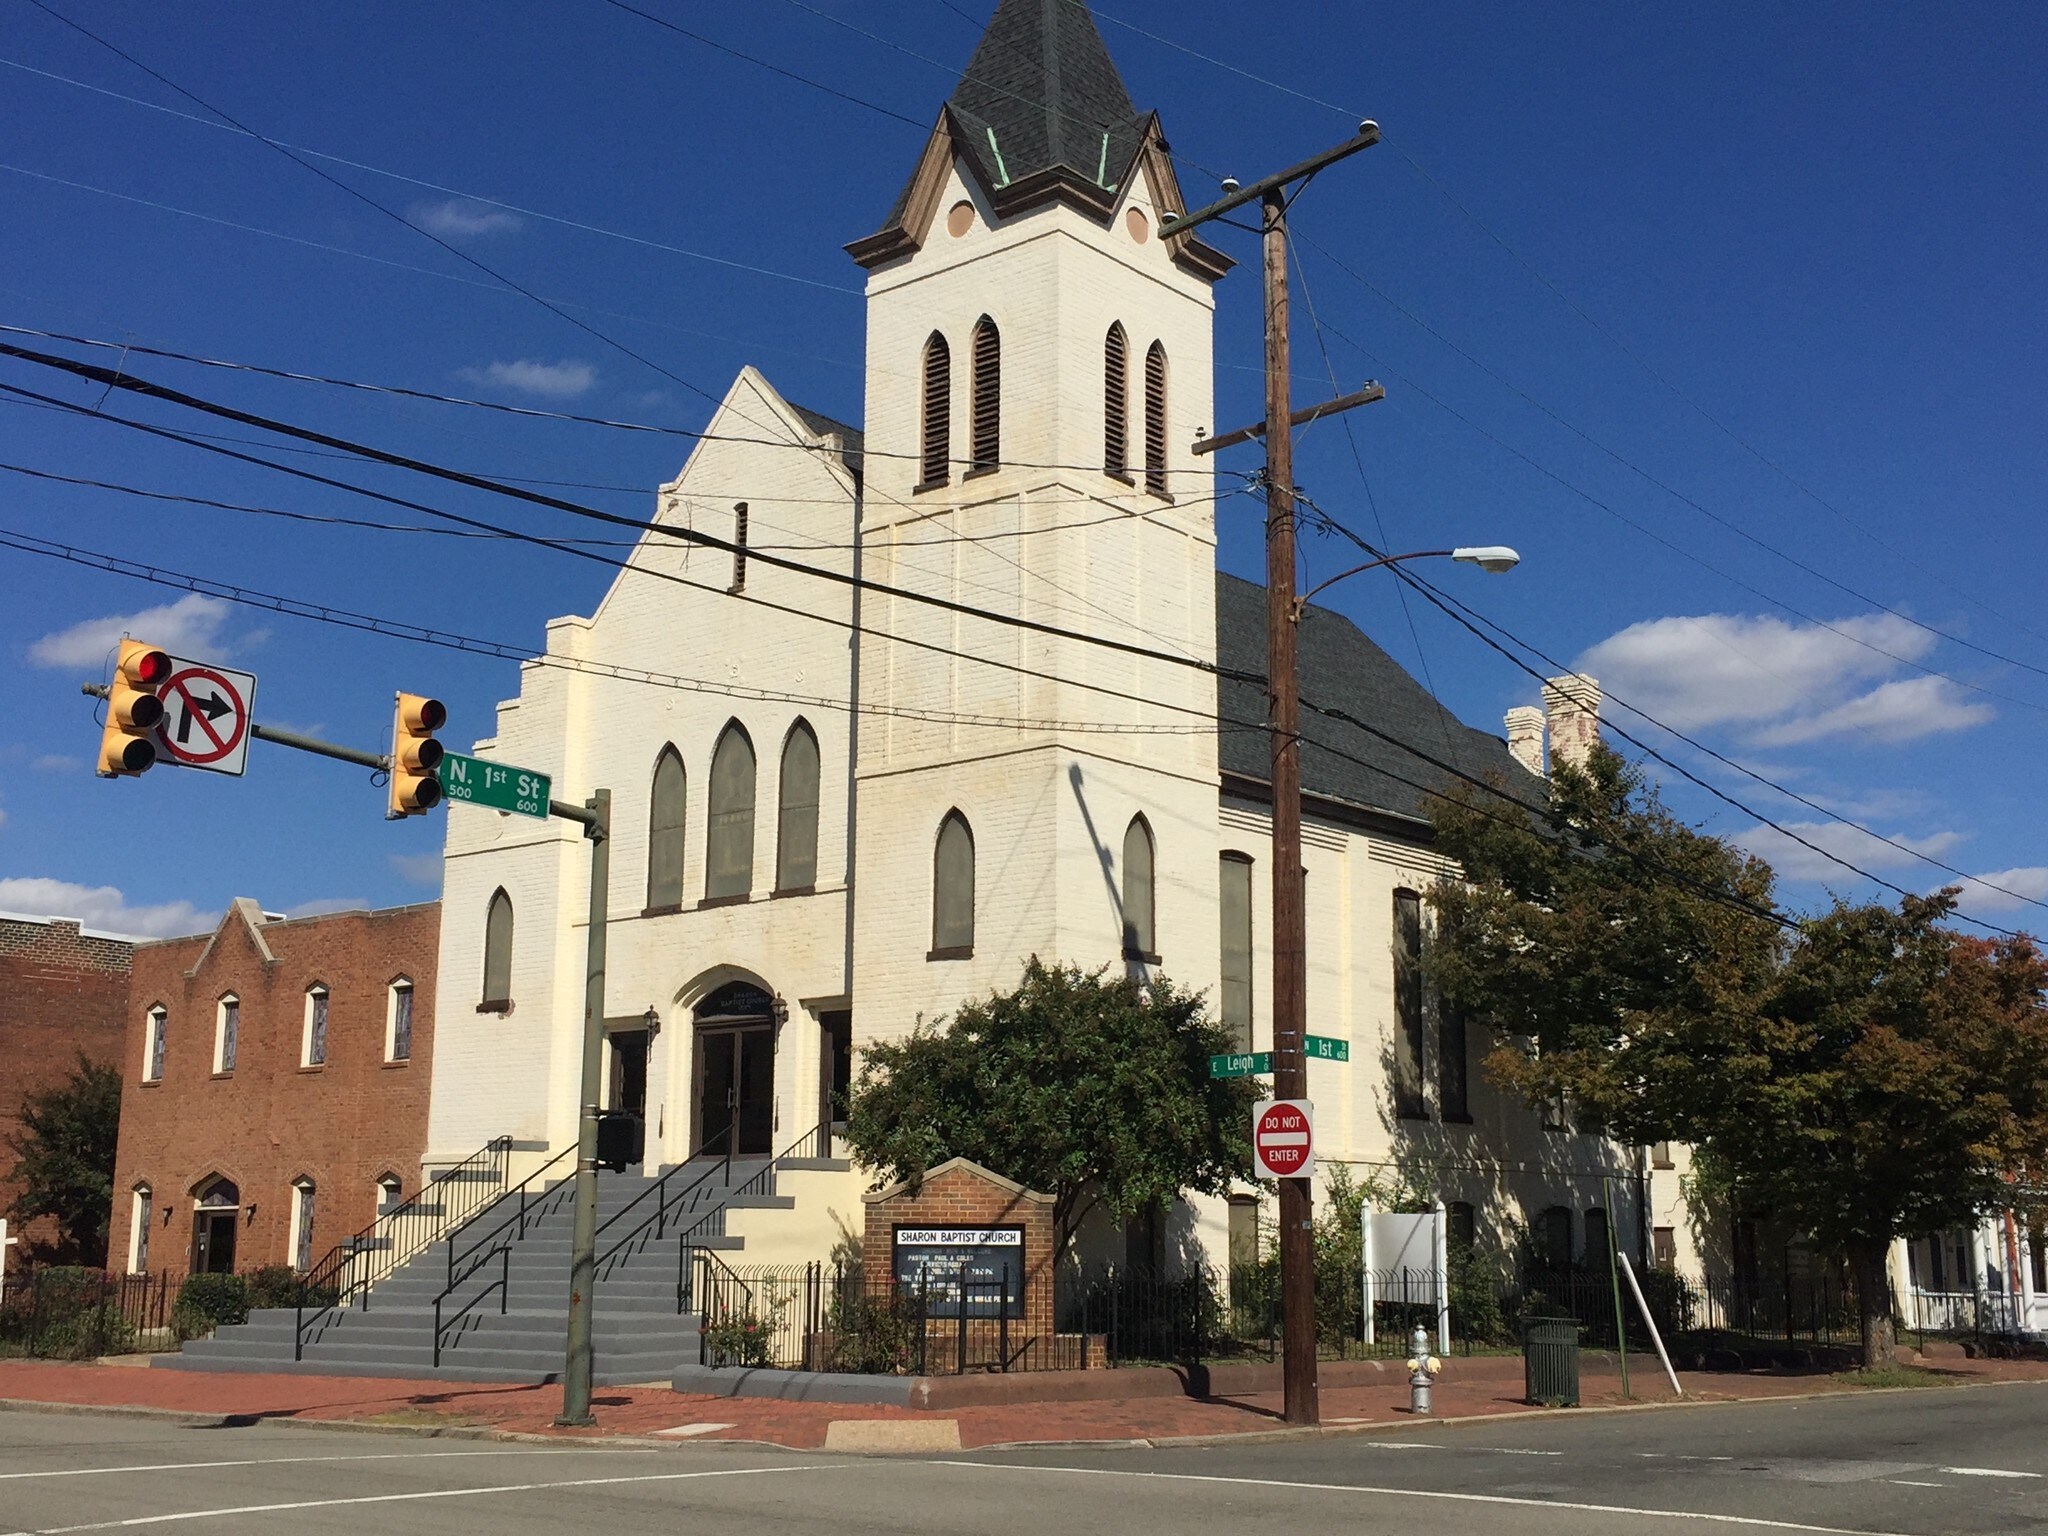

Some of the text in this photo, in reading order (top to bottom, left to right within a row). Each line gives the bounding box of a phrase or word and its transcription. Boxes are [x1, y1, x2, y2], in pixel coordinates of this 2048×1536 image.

[485, 767, 507, 788] 1st
[517, 775, 539, 799] St
[449, 785, 537, 813] 500 600
[1305, 1040, 1309, 1050] N
[1319, 1039, 1332, 1056] 1st
[1336, 1051, 1346, 1059] 600
[1213, 1062, 1217, 1072] E
[1227, 1055, 1254, 1073] Leigh
[1266, 1116, 1300, 1129] DO NOT
[1269, 1150, 1298, 1162] ENTER
[901, 1232, 1016, 1242] SHARON BAPTIST CHURCH
